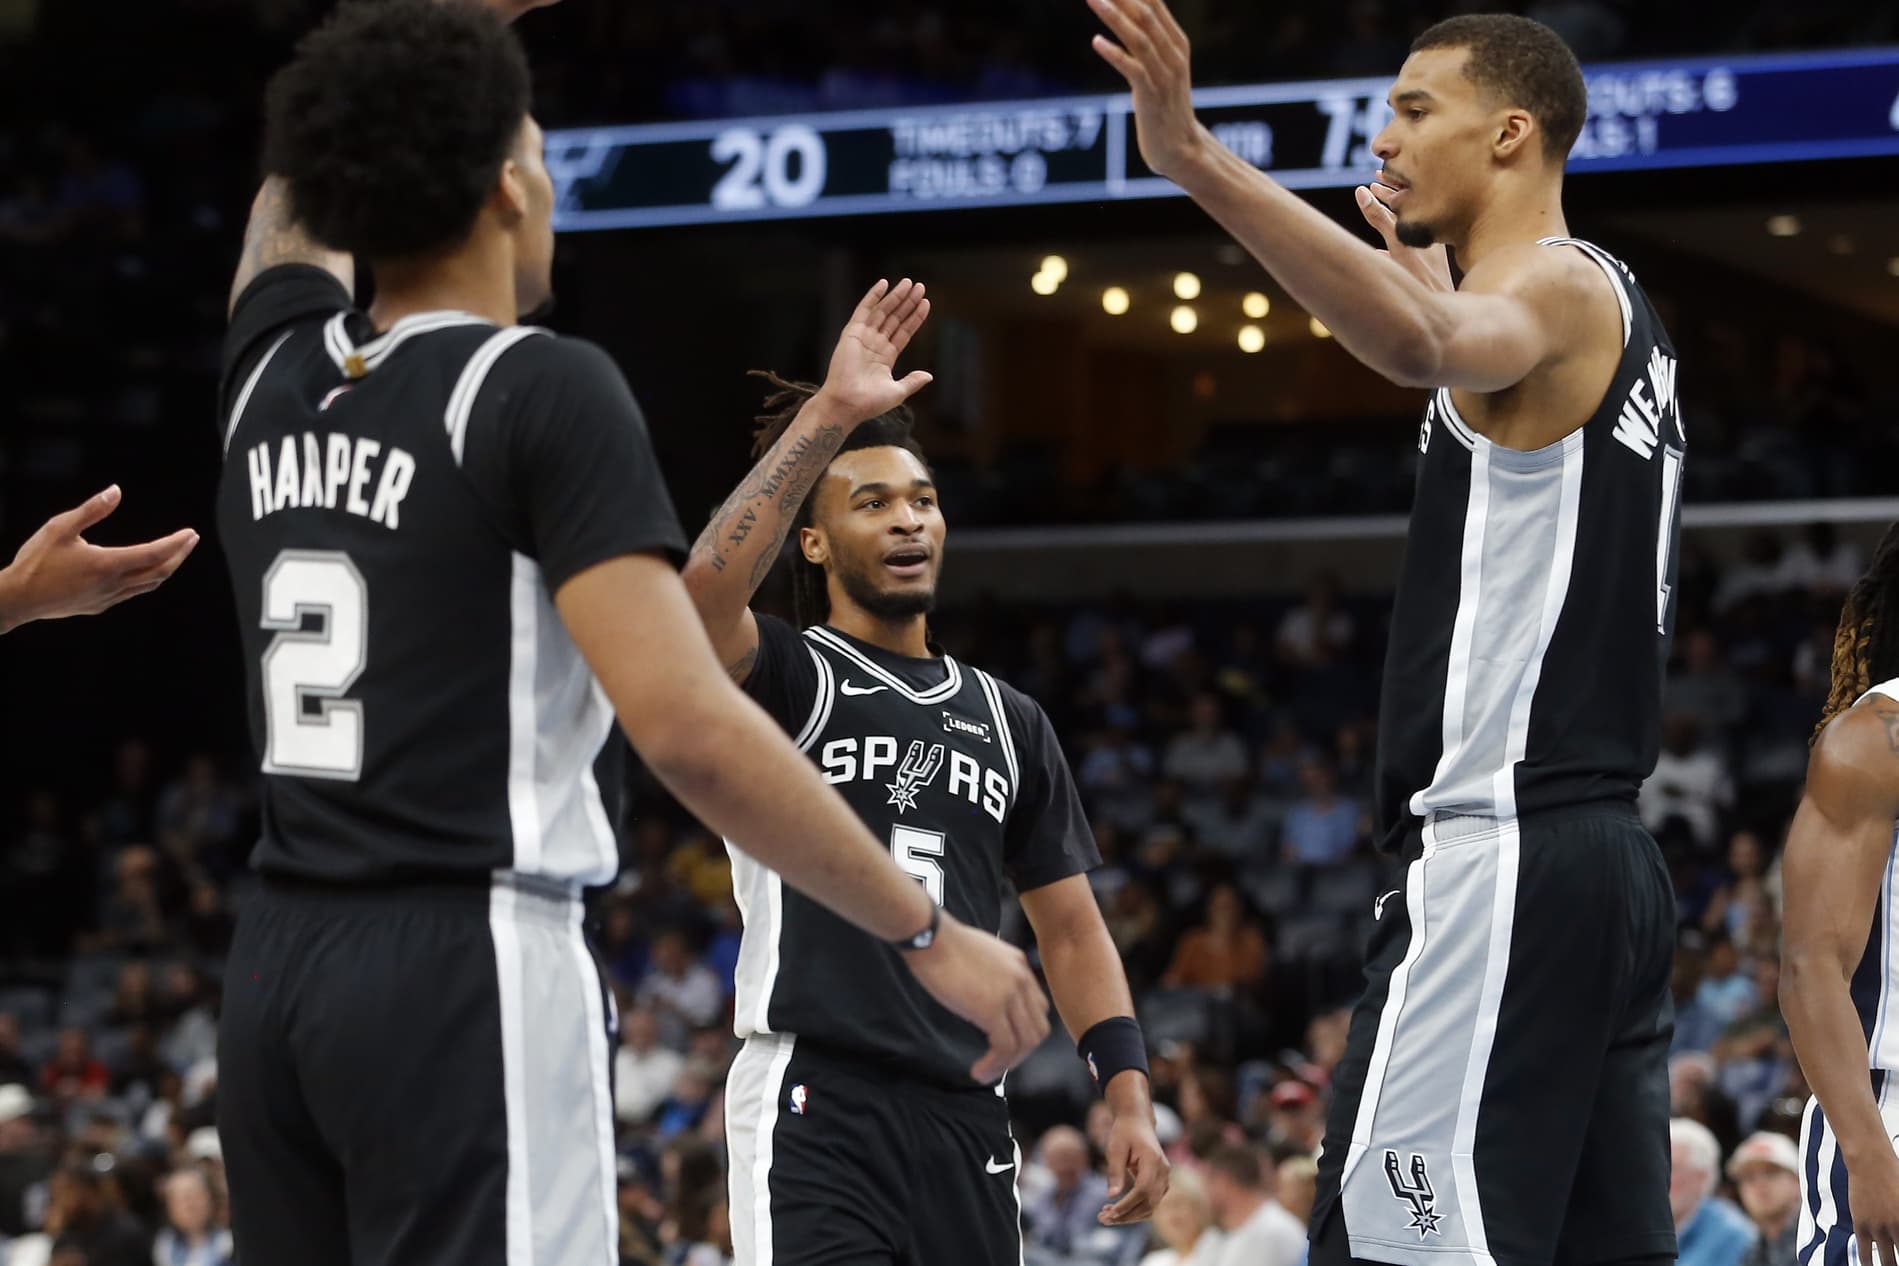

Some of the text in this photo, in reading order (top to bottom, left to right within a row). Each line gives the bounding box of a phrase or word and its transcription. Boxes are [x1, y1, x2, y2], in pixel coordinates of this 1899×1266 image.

[1587, 71, 1702, 118] OUTS:
[709, 123, 827, 210] 20
[248, 431, 416, 530] HARPER
[260, 548, 369, 782] 2
[948, 717, 985, 737] LEDGER
[821, 736, 1009, 824] SPURS
[890, 823, 946, 908] 5
